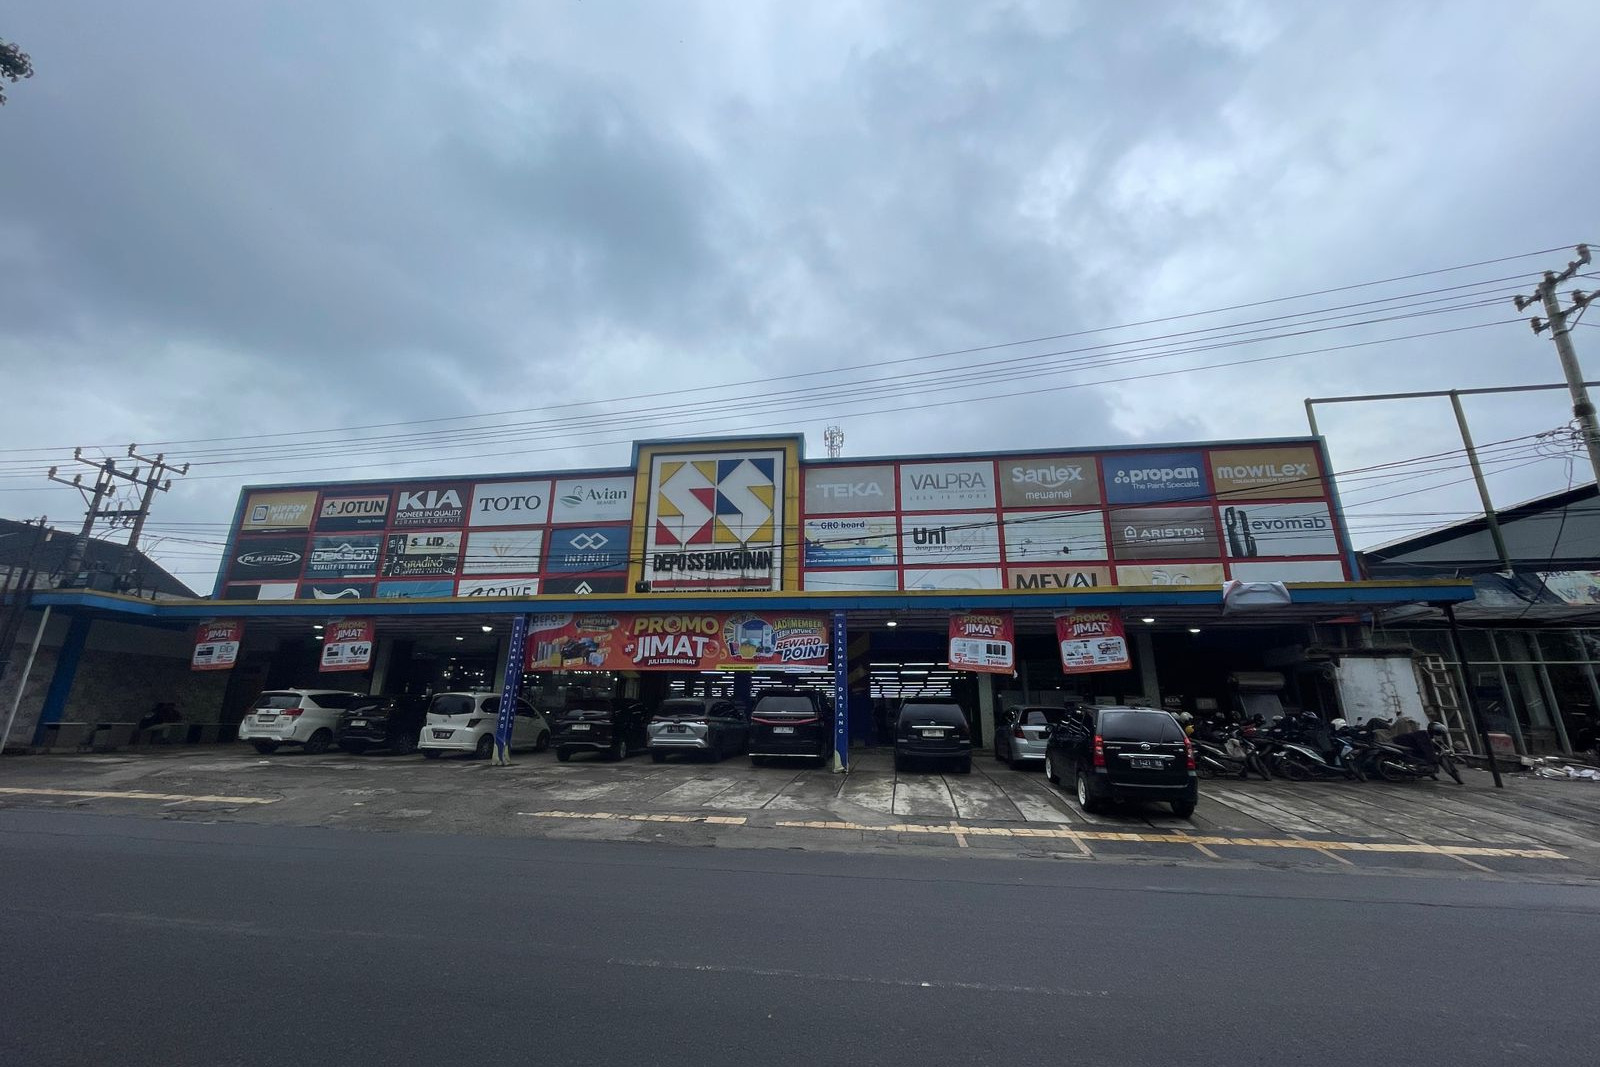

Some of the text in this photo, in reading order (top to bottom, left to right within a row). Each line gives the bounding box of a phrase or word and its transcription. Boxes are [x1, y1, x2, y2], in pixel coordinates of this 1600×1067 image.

[910, 472, 986, 490] VALPRA
[1012, 466, 1082, 482] Sanlex
[1129, 467, 1199, 482] propan
[586, 488, 627, 500] Avian
[816, 482, 884, 498] TEKA
[398, 490, 463, 510] KIA
[480, 495, 541, 511] TOTO
[337, 501, 385, 514] JOTUN
[1252, 516, 1326, 530] evomab
[913, 526, 946, 544] Uni
[1140, 528, 1204, 537] ARISTON
[410, 537, 445, 546] SLID
[653, 551, 773, 572] DEPO SS BANGUNAN
[633, 615, 719, 635] PROMO
[963, 615, 1003, 626] PROMO
[207, 629, 233, 641] JIMAT
[336, 629, 363, 640] JIMAT
[964, 623, 999, 635] JIMAT
[1073, 622, 1107, 636] JIMAT
[632, 635, 709, 663] JIMAT
[775, 637, 821, 650] REWARD
[783, 645, 829, 661] POINT
